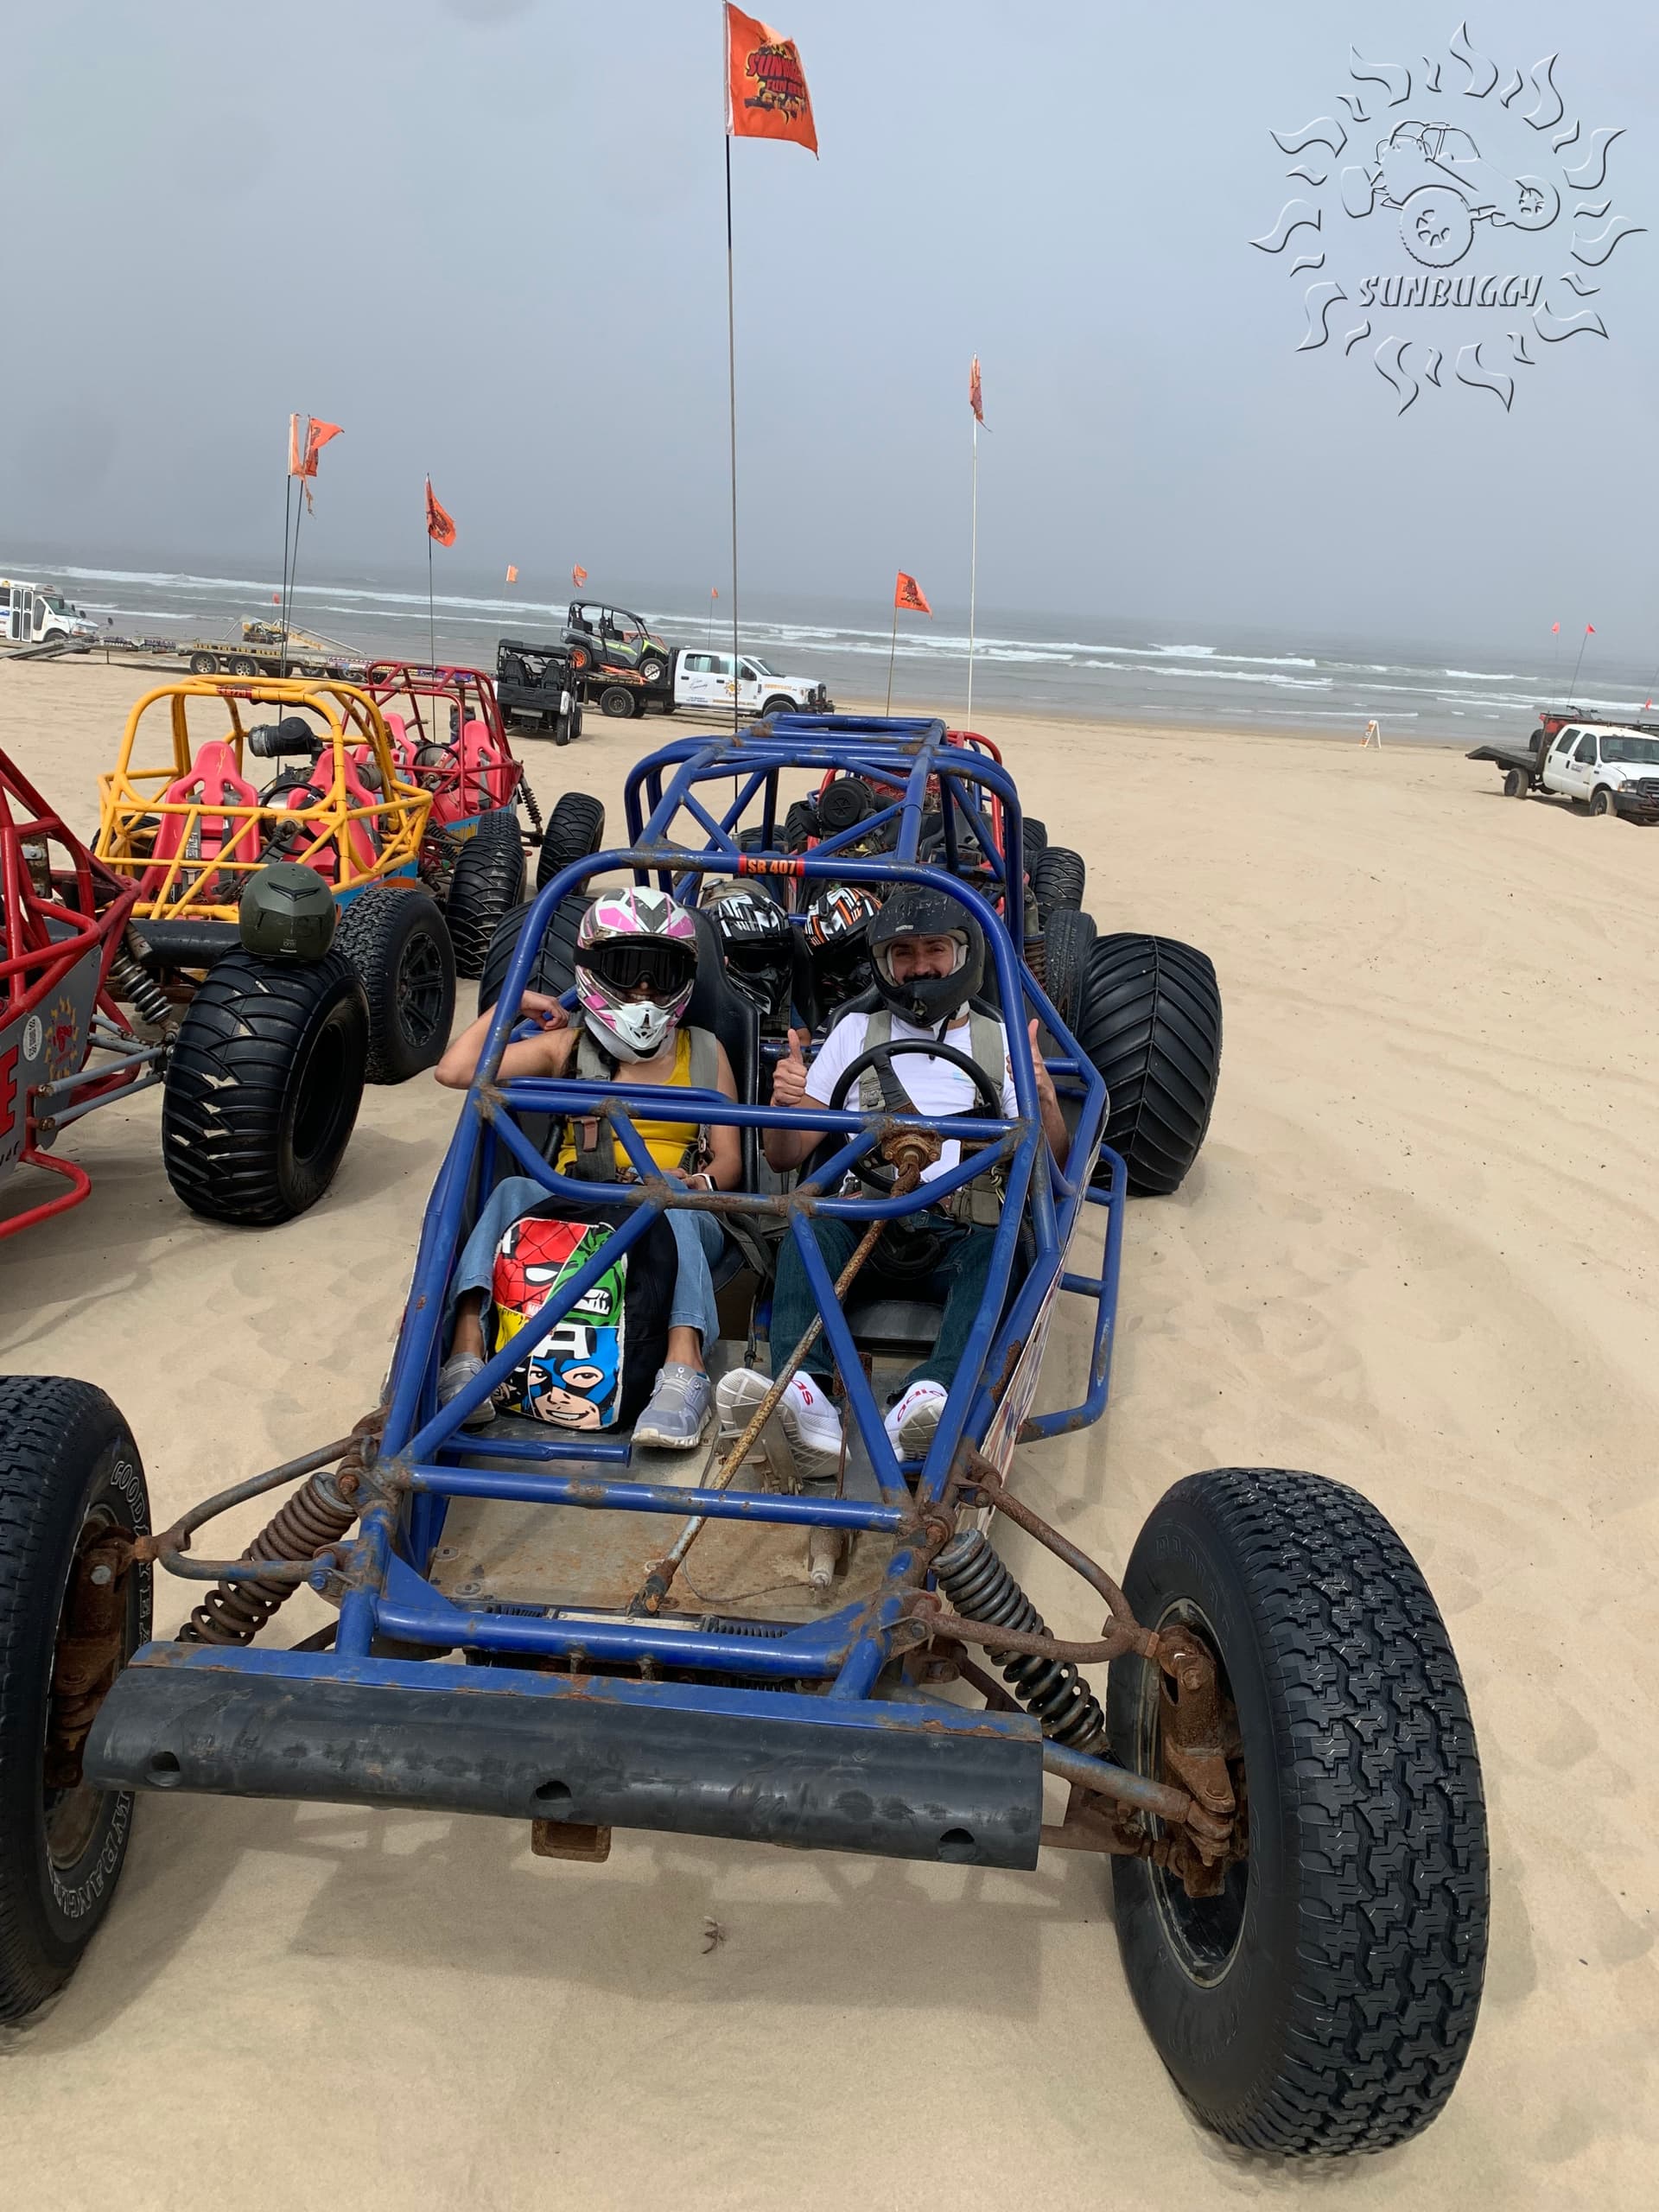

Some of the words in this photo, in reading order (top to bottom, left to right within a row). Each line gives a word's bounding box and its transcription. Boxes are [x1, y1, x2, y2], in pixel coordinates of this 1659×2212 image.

[747, 859, 766, 874] SB
[769, 860, 796, 875] 407
[896, 1388, 944, 1423] adid
[111, 1460, 152, 1648] GOODYEA
